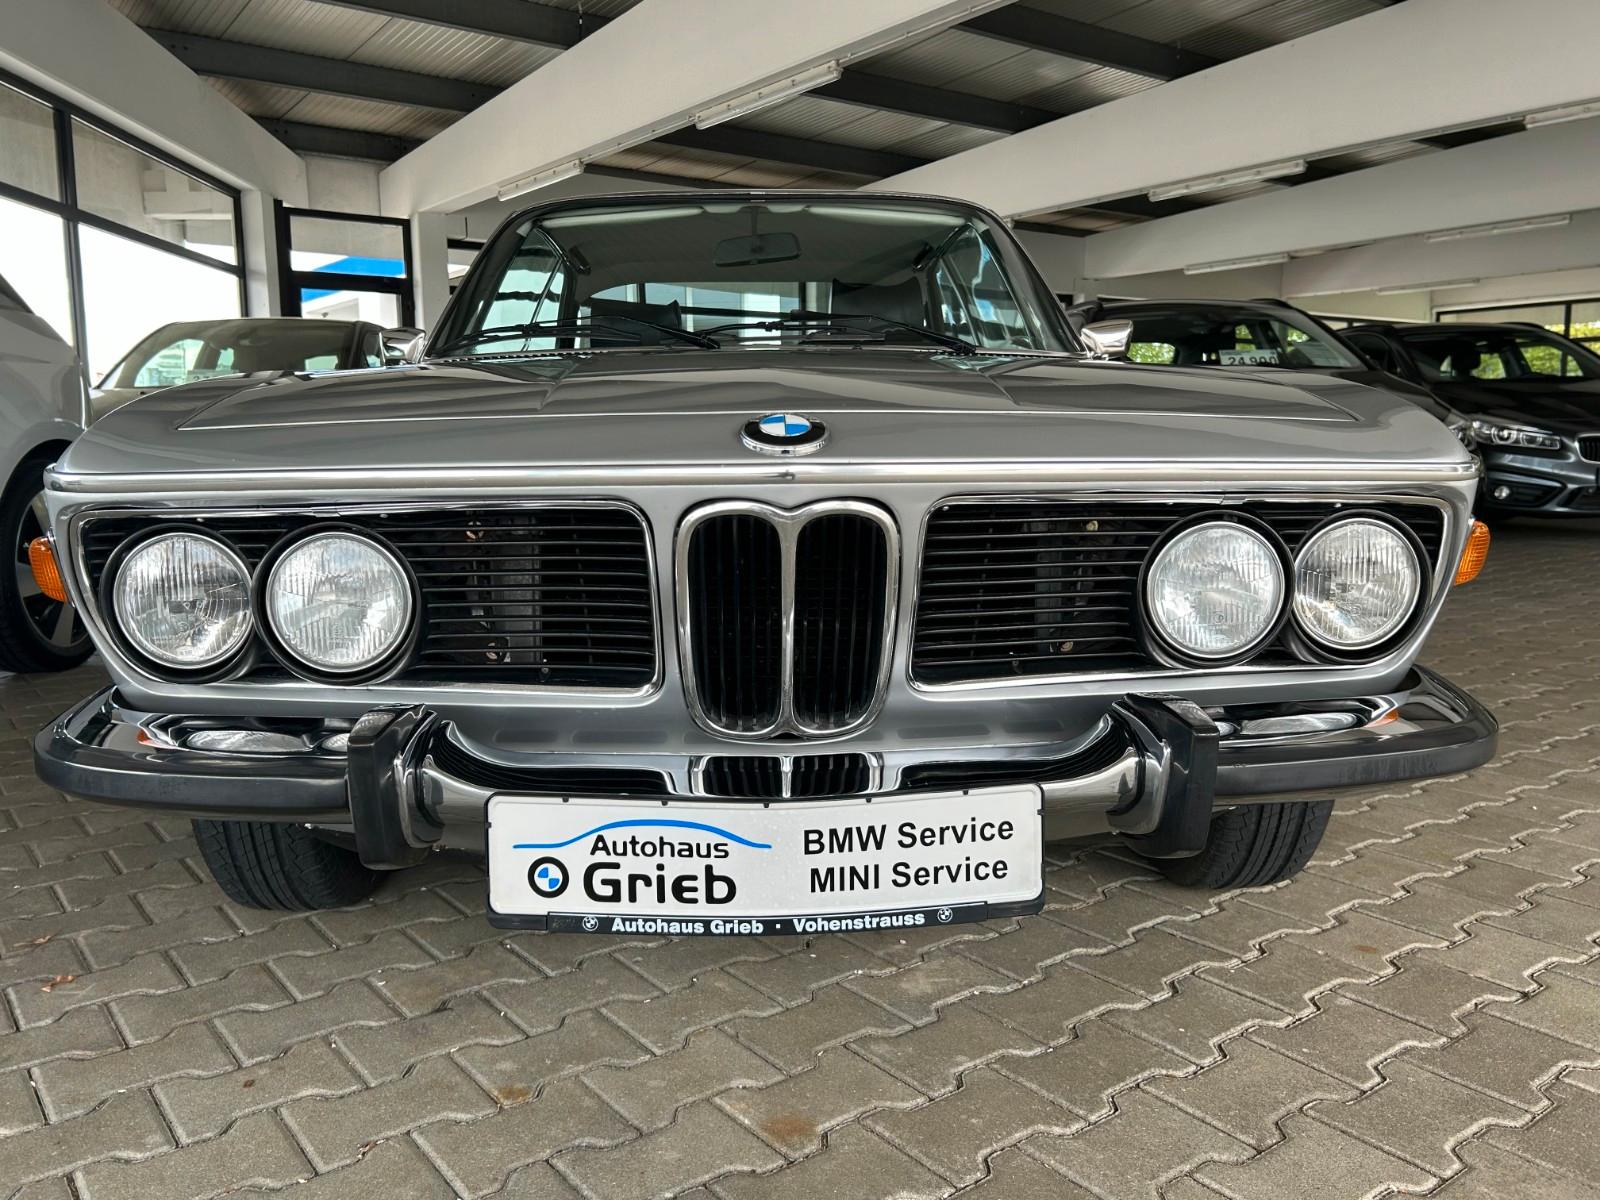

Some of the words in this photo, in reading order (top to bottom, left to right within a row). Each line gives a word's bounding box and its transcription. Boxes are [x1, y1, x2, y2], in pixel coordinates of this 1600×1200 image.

[589, 833, 730, 859] Autohaus
[803, 824, 887, 856] BMW
[897, 816, 1014, 849] Service
[583, 861, 737, 905] Grieb
[810, 864, 880, 893] MINI
[891, 856, 1008, 888] Service
[611, 917, 705, 934] Autohaus
[710, 919, 765, 935] Grieb
[792, 912, 926, 933] Vohenstrauss
